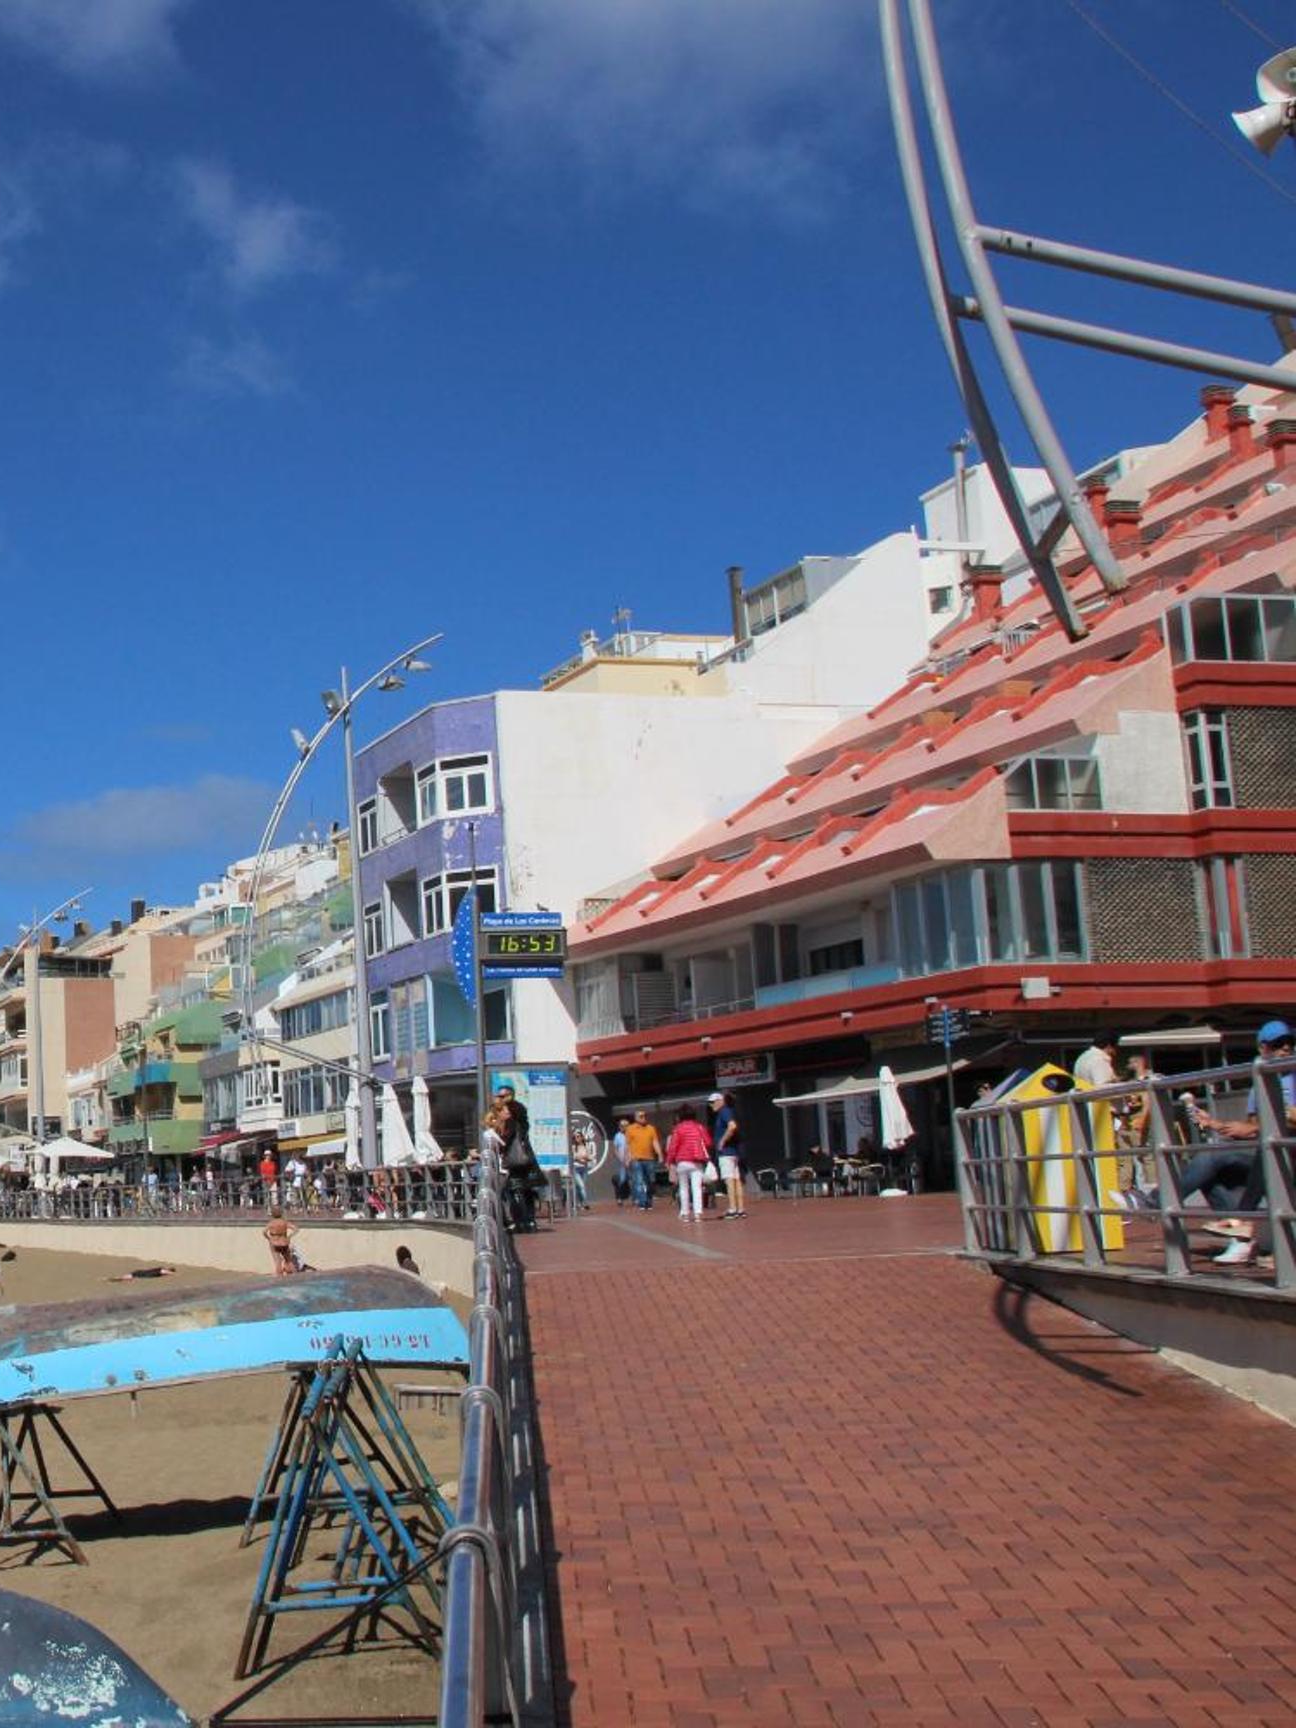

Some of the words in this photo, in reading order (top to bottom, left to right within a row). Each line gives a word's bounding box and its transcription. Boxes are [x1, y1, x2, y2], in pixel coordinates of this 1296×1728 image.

[483, 916, 503, 926] Playa
[500, 936, 556, 952] 16:53
[718, 1058, 756, 1075] SPAR
